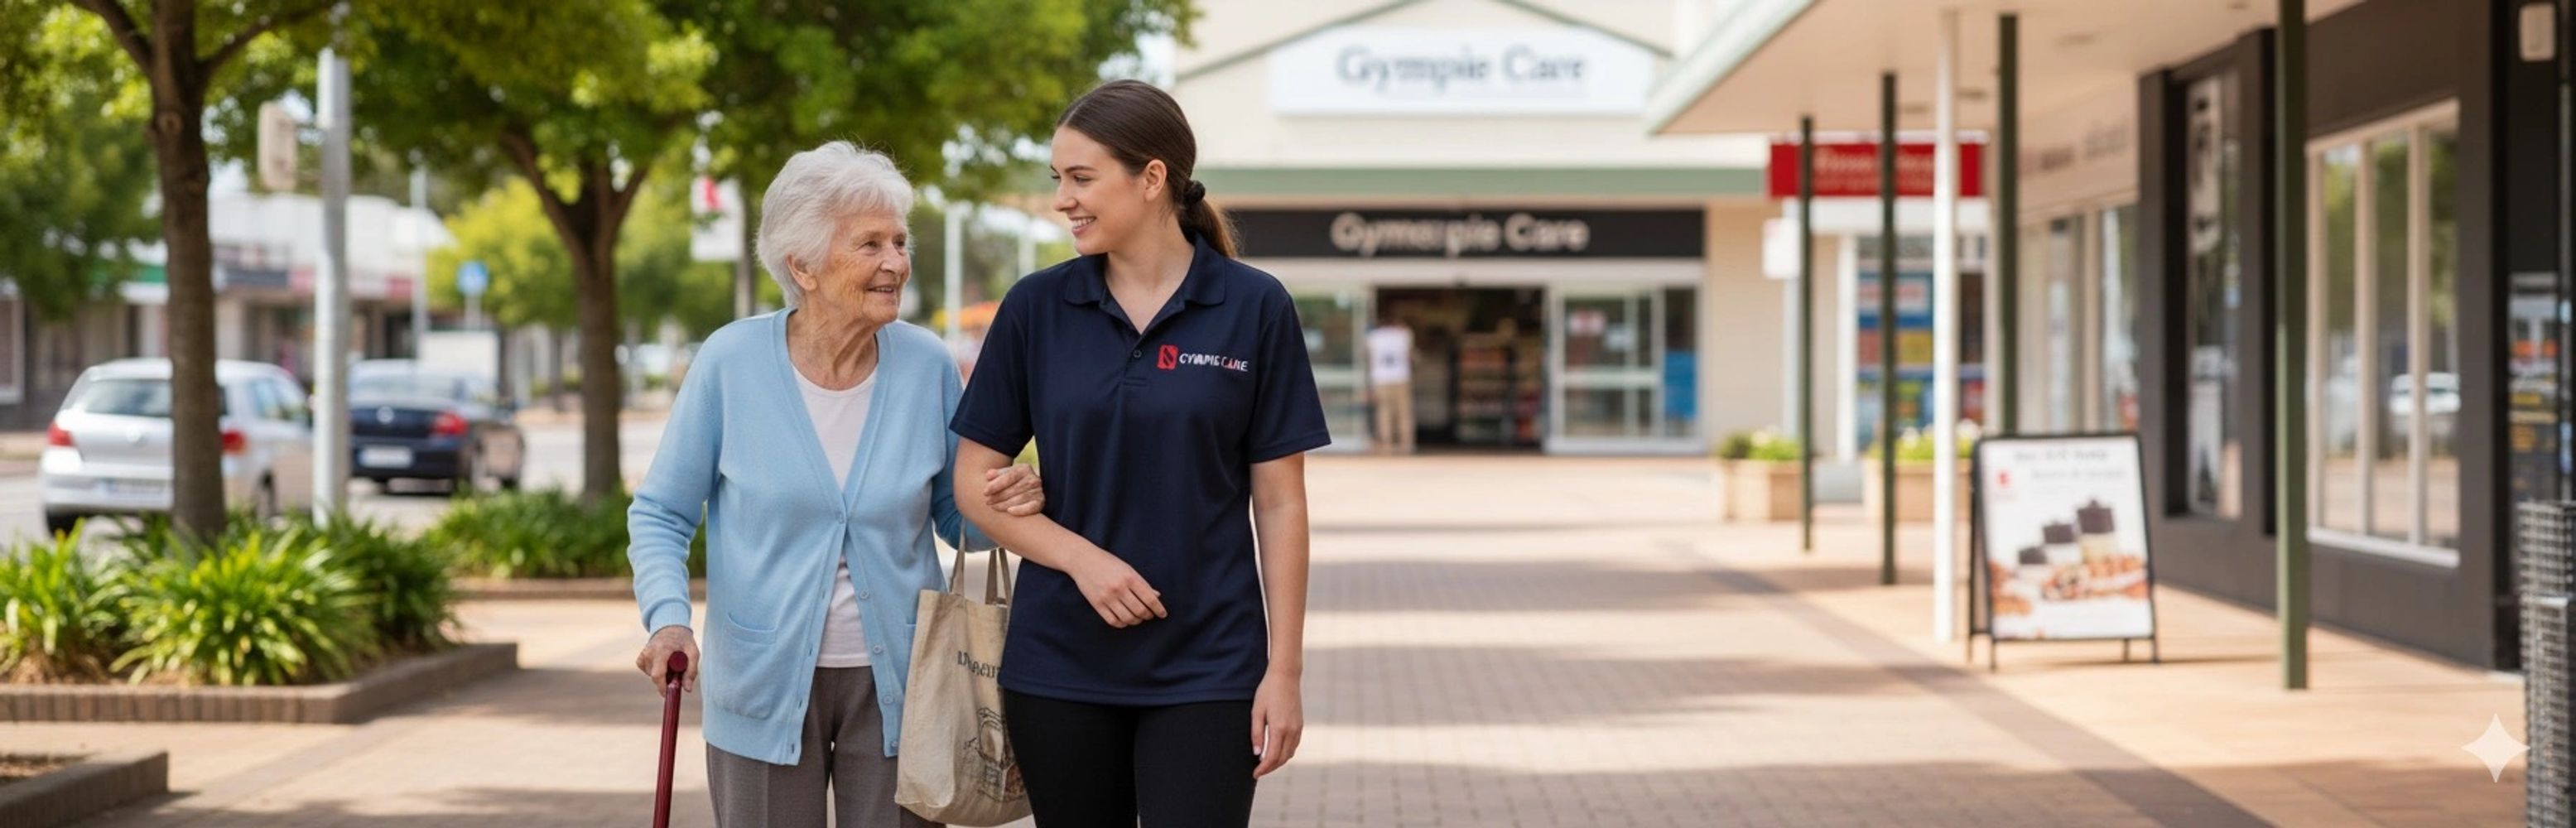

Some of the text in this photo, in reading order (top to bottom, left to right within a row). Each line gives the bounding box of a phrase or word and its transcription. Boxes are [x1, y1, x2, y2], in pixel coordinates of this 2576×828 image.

[1336, 45, 1586, 93] Gympie Care
[1505, 212, 1591, 252] Care
